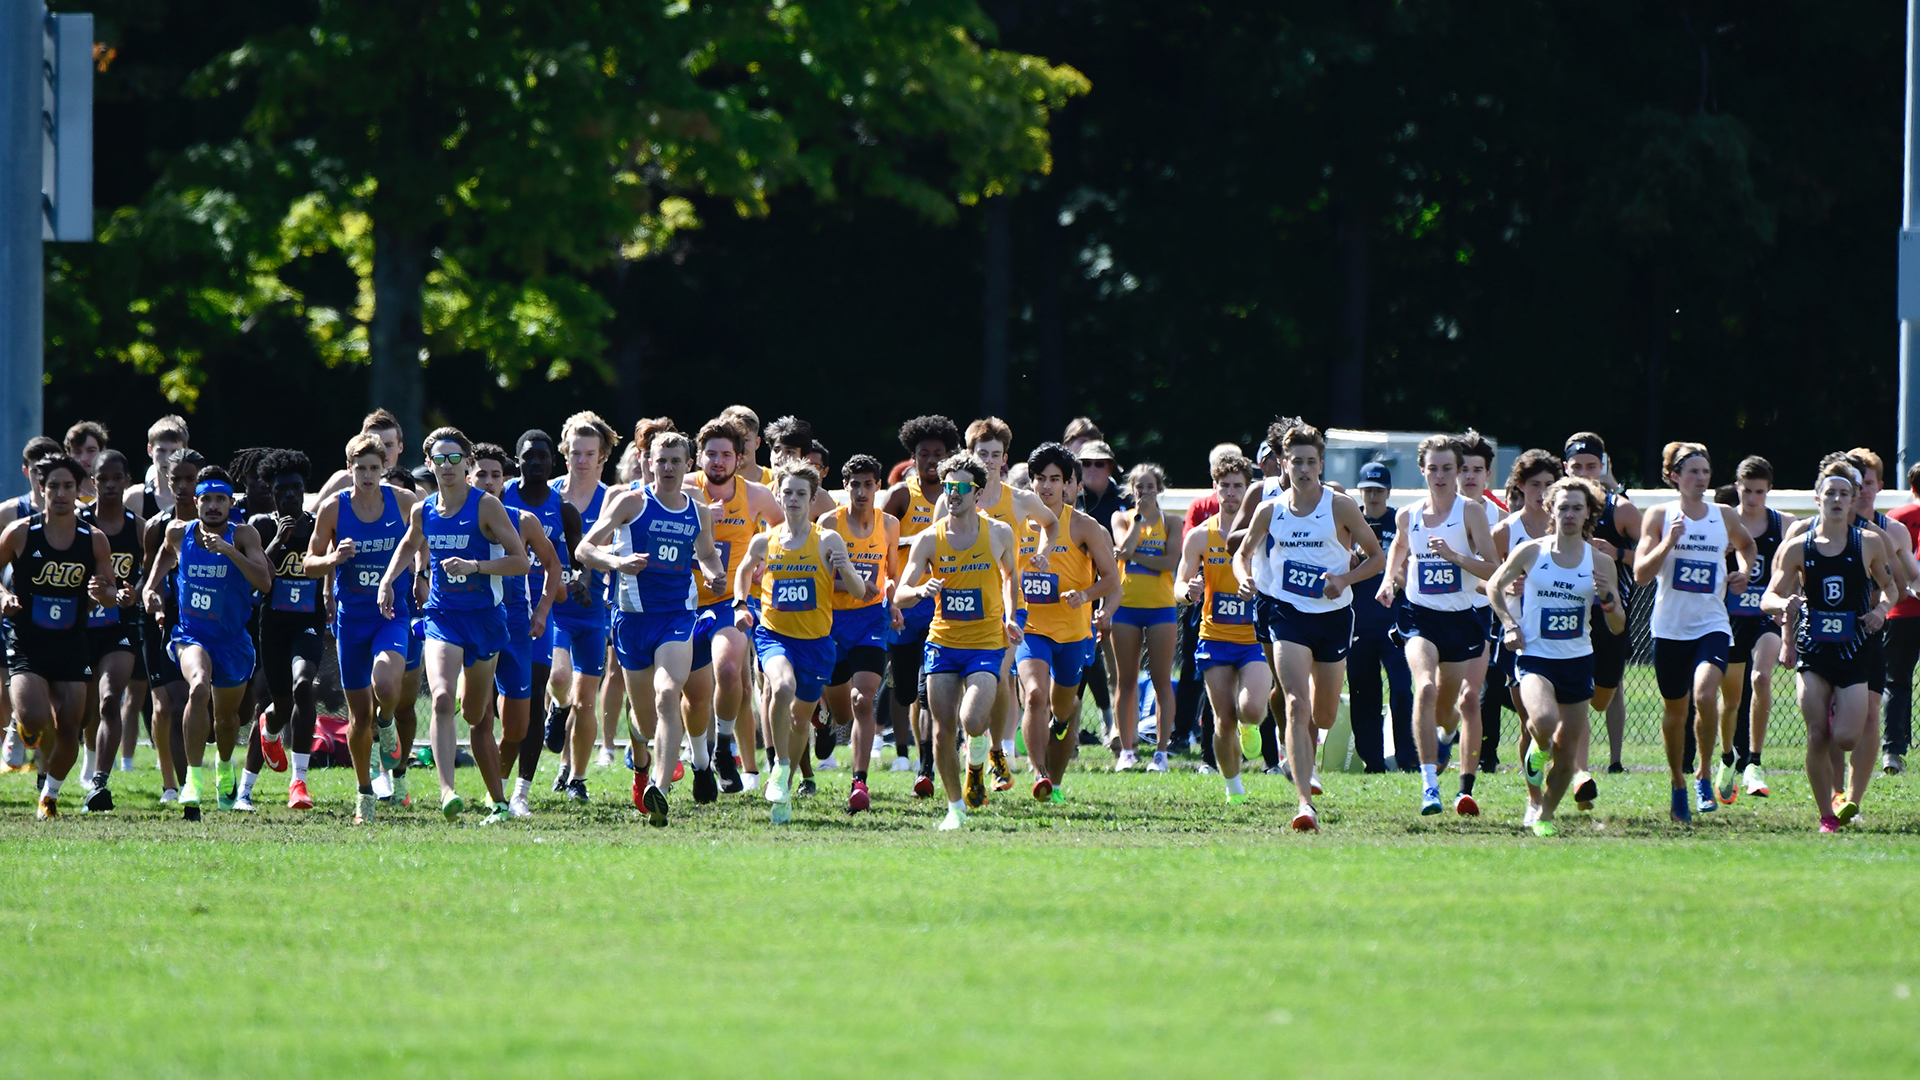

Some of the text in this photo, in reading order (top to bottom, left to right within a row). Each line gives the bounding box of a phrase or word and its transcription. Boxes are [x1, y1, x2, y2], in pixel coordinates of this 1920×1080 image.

[648, 519, 696, 537] CCSU
[354, 537, 395, 553] CCSU
[427, 534, 470, 550] CCSU
[1279, 540, 1324, 548] HAMPSHIRE
[1674, 544, 1719, 552] HAMPSHIRE
[657, 544, 679, 562] 90
[1019, 546, 1037, 555] NEW
[110, 553, 134, 578] IC
[767, 563, 818, 572] NEW HAVEN
[938, 563, 992, 574] NEW HAVEN
[1207, 557, 1227, 565] NEW
[32, 561, 86, 588] AIC
[187, 564, 228, 578] CCSU
[358, 571, 380, 586] 92
[1288, 568, 1318, 588] 237
[1423, 568, 1455, 585] 245
[1679, 566, 1711, 584] 242
[1023, 579, 1051, 596] 259
[1553, 580, 1576, 590] NEW
[1826, 582, 1841, 600] B
[190, 592, 212, 610] 89
[289, 587, 301, 603] 5
[778, 586, 808, 602] 260
[1537, 589, 1586, 604] HAMPSHIRE
[1739, 593, 1760, 607] 28
[49, 604, 62, 620] 6
[946, 596, 975, 612] 262
[1217, 599, 1245, 616] 261
[1547, 614, 1578, 631] 238
[1821, 618, 1843, 634] 29
